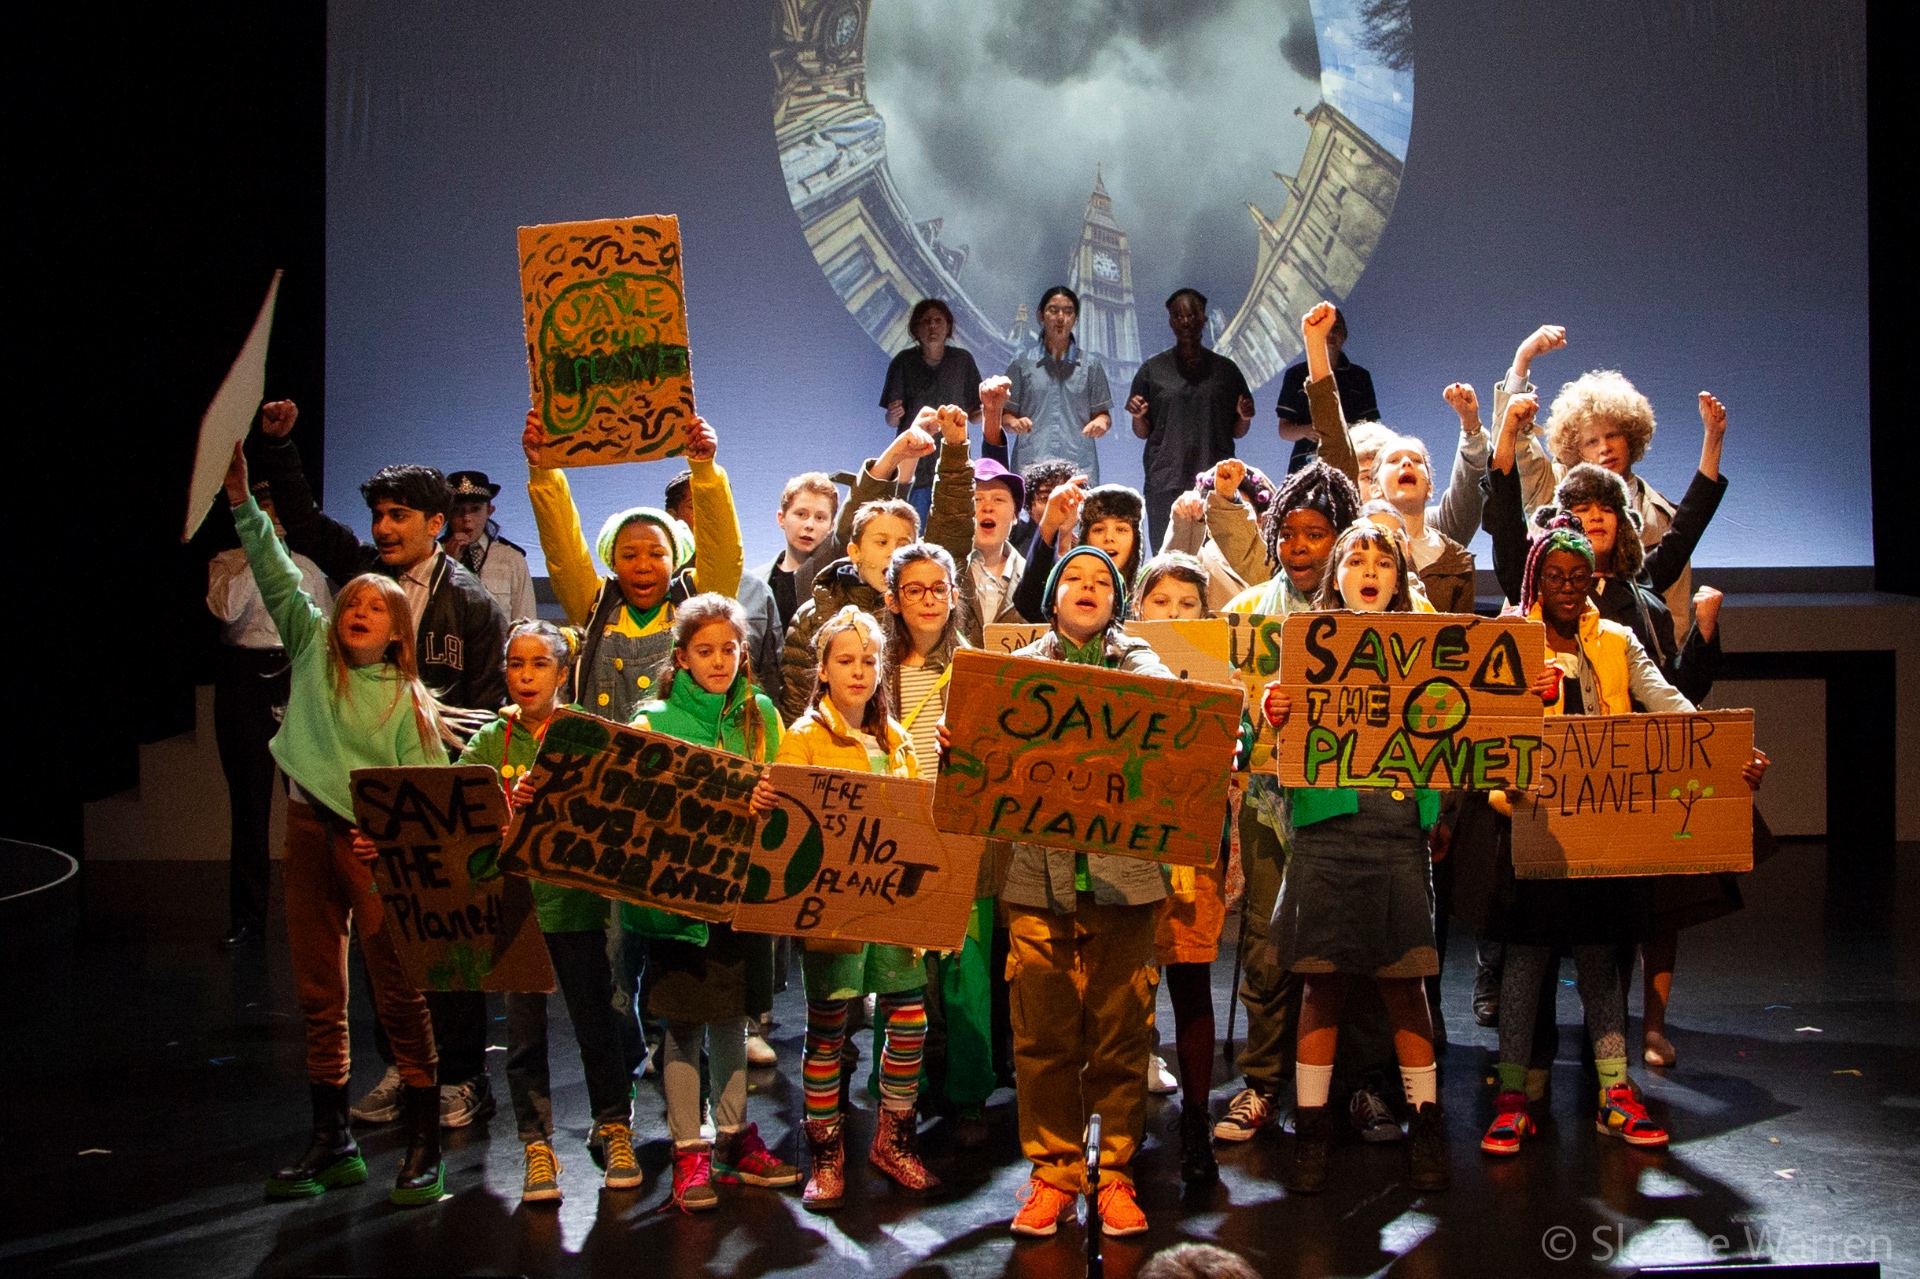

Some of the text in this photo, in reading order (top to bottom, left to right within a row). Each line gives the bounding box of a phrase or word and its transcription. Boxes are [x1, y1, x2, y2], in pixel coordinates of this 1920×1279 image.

[563, 287, 665, 327] SAVE
[574, 347, 688, 390] PLANET
[425, 631, 464, 671] LA
[1001, 629, 1043, 654] SAV
[1304, 614, 1470, 685] SAVE
[999, 683, 1170, 750] SAVE
[1306, 684, 1391, 728] THE
[611, 731, 675, 779] TO
[1303, 725, 1543, 790] PLANET
[1644, 717, 1715, 774] OUR
[808, 773, 870, 811] THERE
[1029, 760, 1126, 804] OUR
[1532, 771, 1664, 821] PLANET
[355, 776, 499, 841] SAVE
[822, 814, 848, 838] IS
[848, 816, 898, 866] NO
[377, 845, 452, 889] THE
[814, 861, 940, 906] PLANET
[794, 896, 826, 931] B
